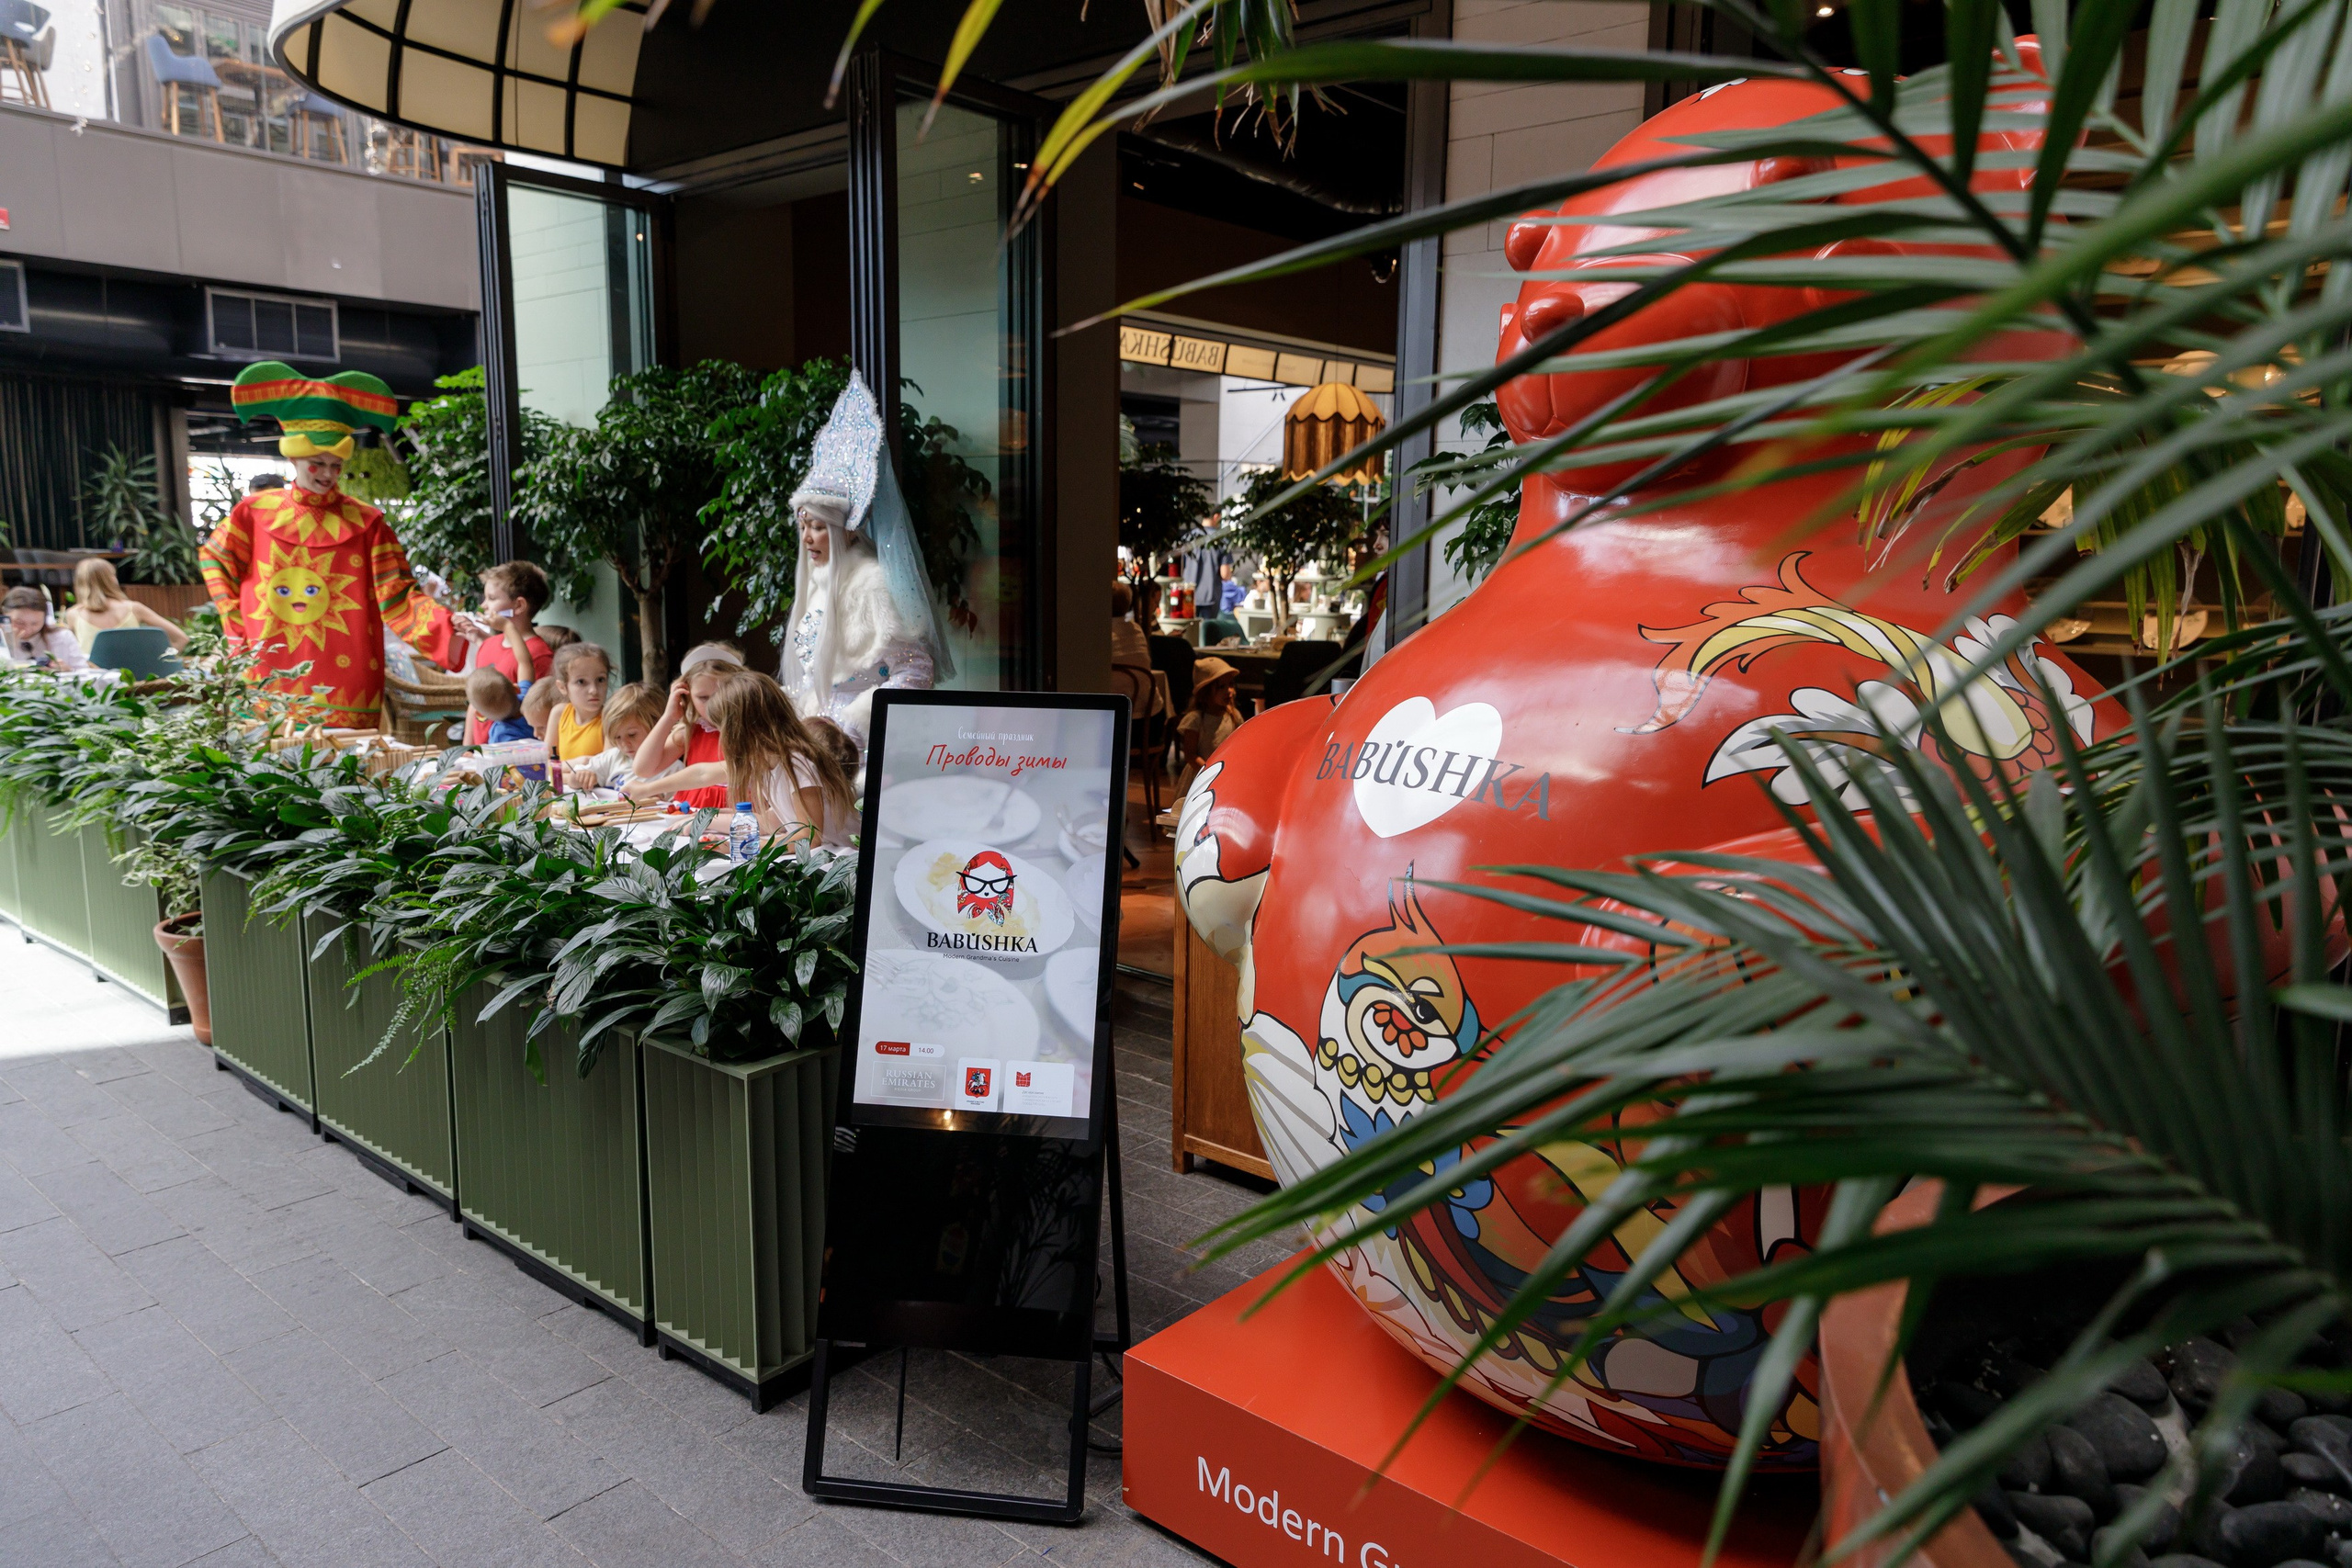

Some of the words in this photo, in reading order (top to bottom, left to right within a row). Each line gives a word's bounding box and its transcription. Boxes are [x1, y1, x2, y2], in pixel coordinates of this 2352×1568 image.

[957, 727, 996, 740] Семейный
[998, 732, 1035, 745] праздник
[926, 744, 1011, 772] Проводы
[1011, 756, 1067, 777] зимы
[882, 1077, 935, 1089] EMIRATES
[886, 1069, 933, 1079] RUSSIAN
[1197, 1456, 1344, 1564] Modern
